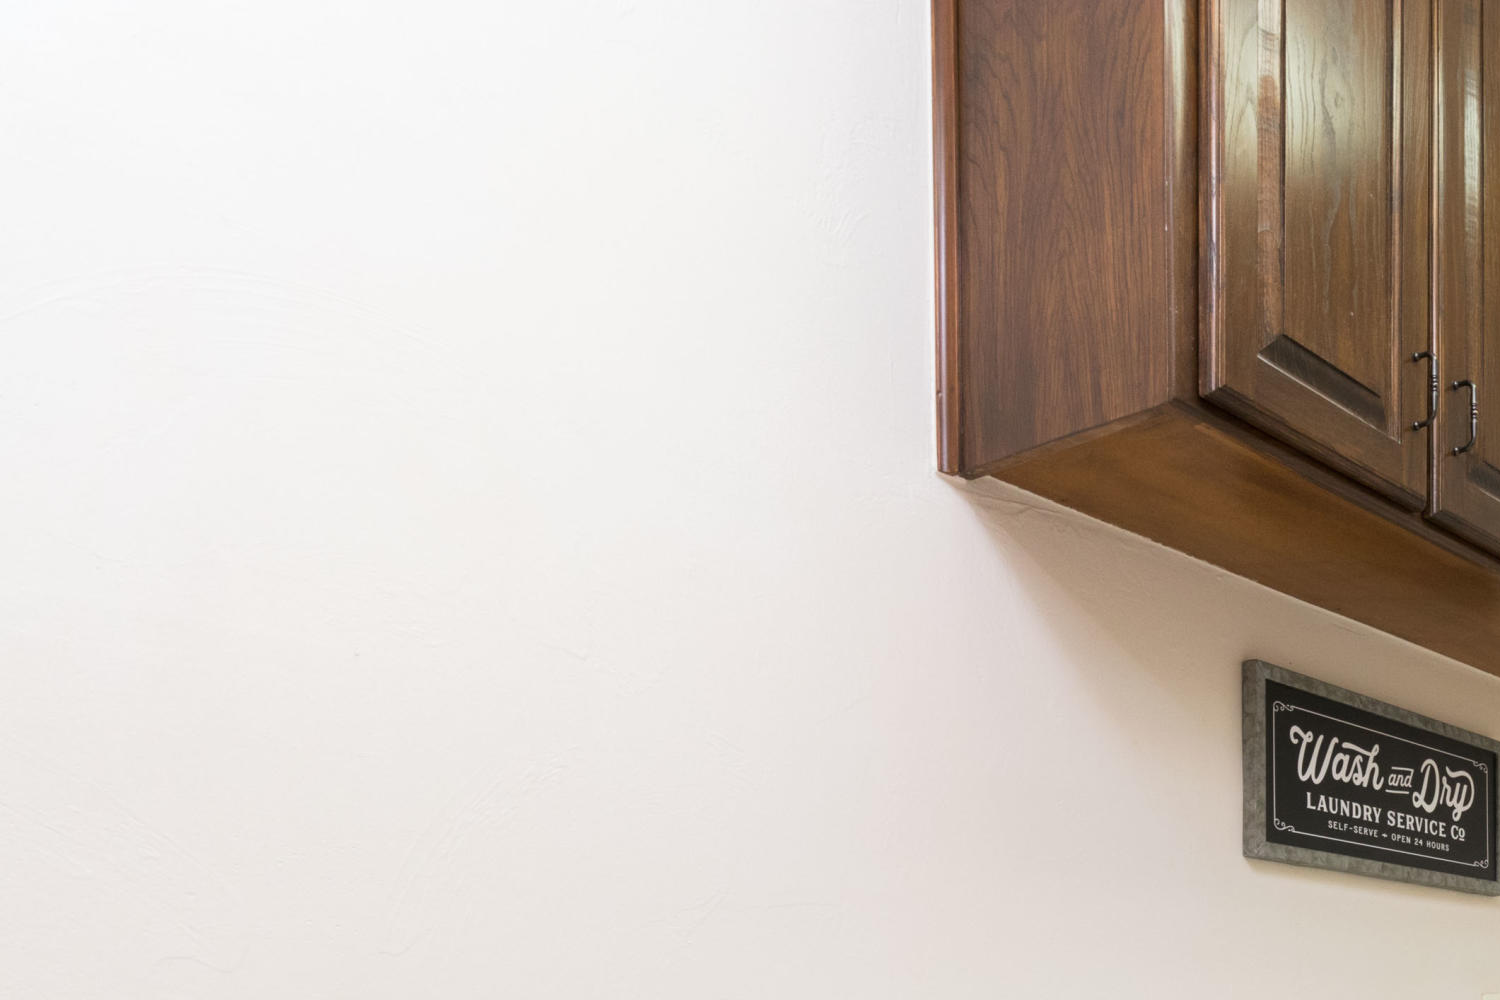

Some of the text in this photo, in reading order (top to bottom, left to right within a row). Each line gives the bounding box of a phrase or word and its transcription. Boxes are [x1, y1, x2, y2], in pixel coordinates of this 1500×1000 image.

[1290, 725, 1475, 821] Wash and Dry
[1306, 792, 1382, 824] LAUNDRY
[1387, 810, 1446, 838] SERVICE
[1327, 820, 1450, 852] SELF-SERVE OPEN 24 HOURS
